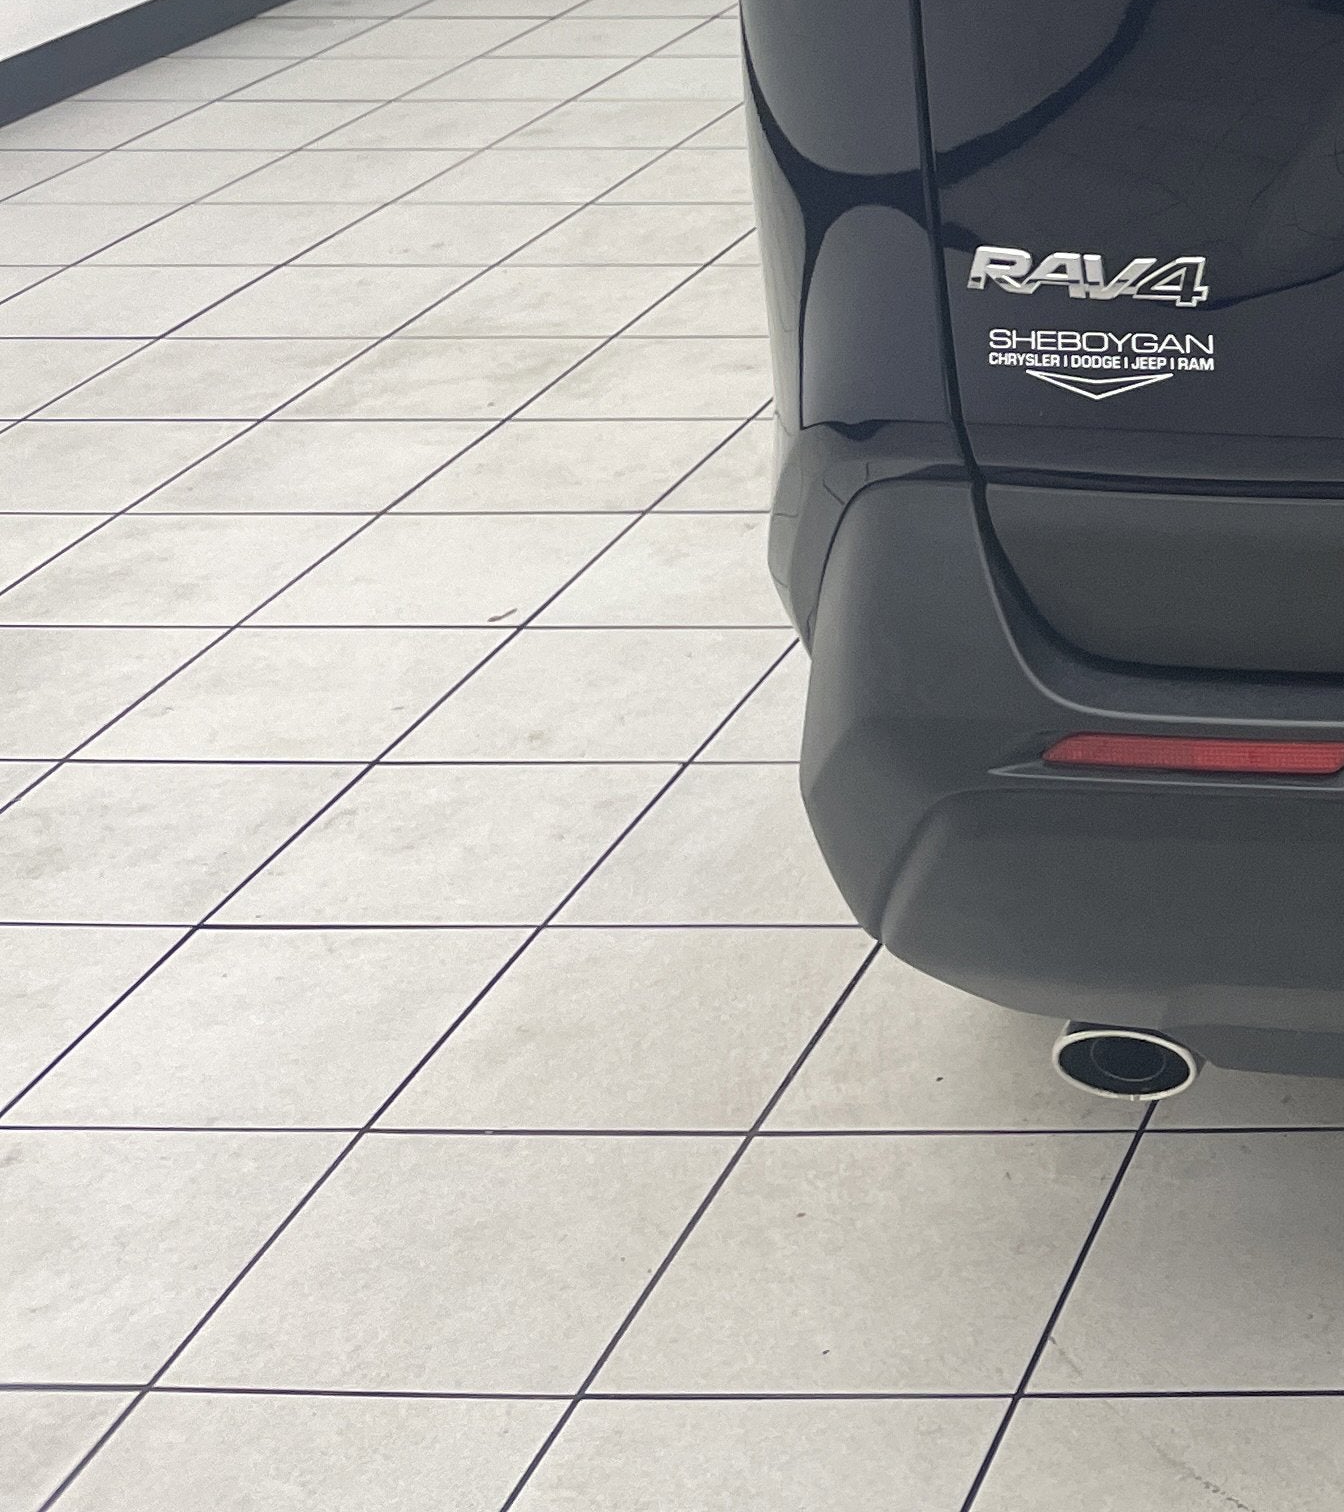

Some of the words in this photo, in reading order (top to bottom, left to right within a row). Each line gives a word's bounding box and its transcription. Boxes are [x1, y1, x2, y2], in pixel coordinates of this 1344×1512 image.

[967, 245, 1209, 307] RAV4
[988, 328, 1215, 355] SHEBOYGAN
[988, 352, 1061, 368] CHRYSLER
[1071, 355, 1121, 370] DODGE
[1131, 356, 1166, 370] JEEP
[1178, 357, 1215, 371] RAM
